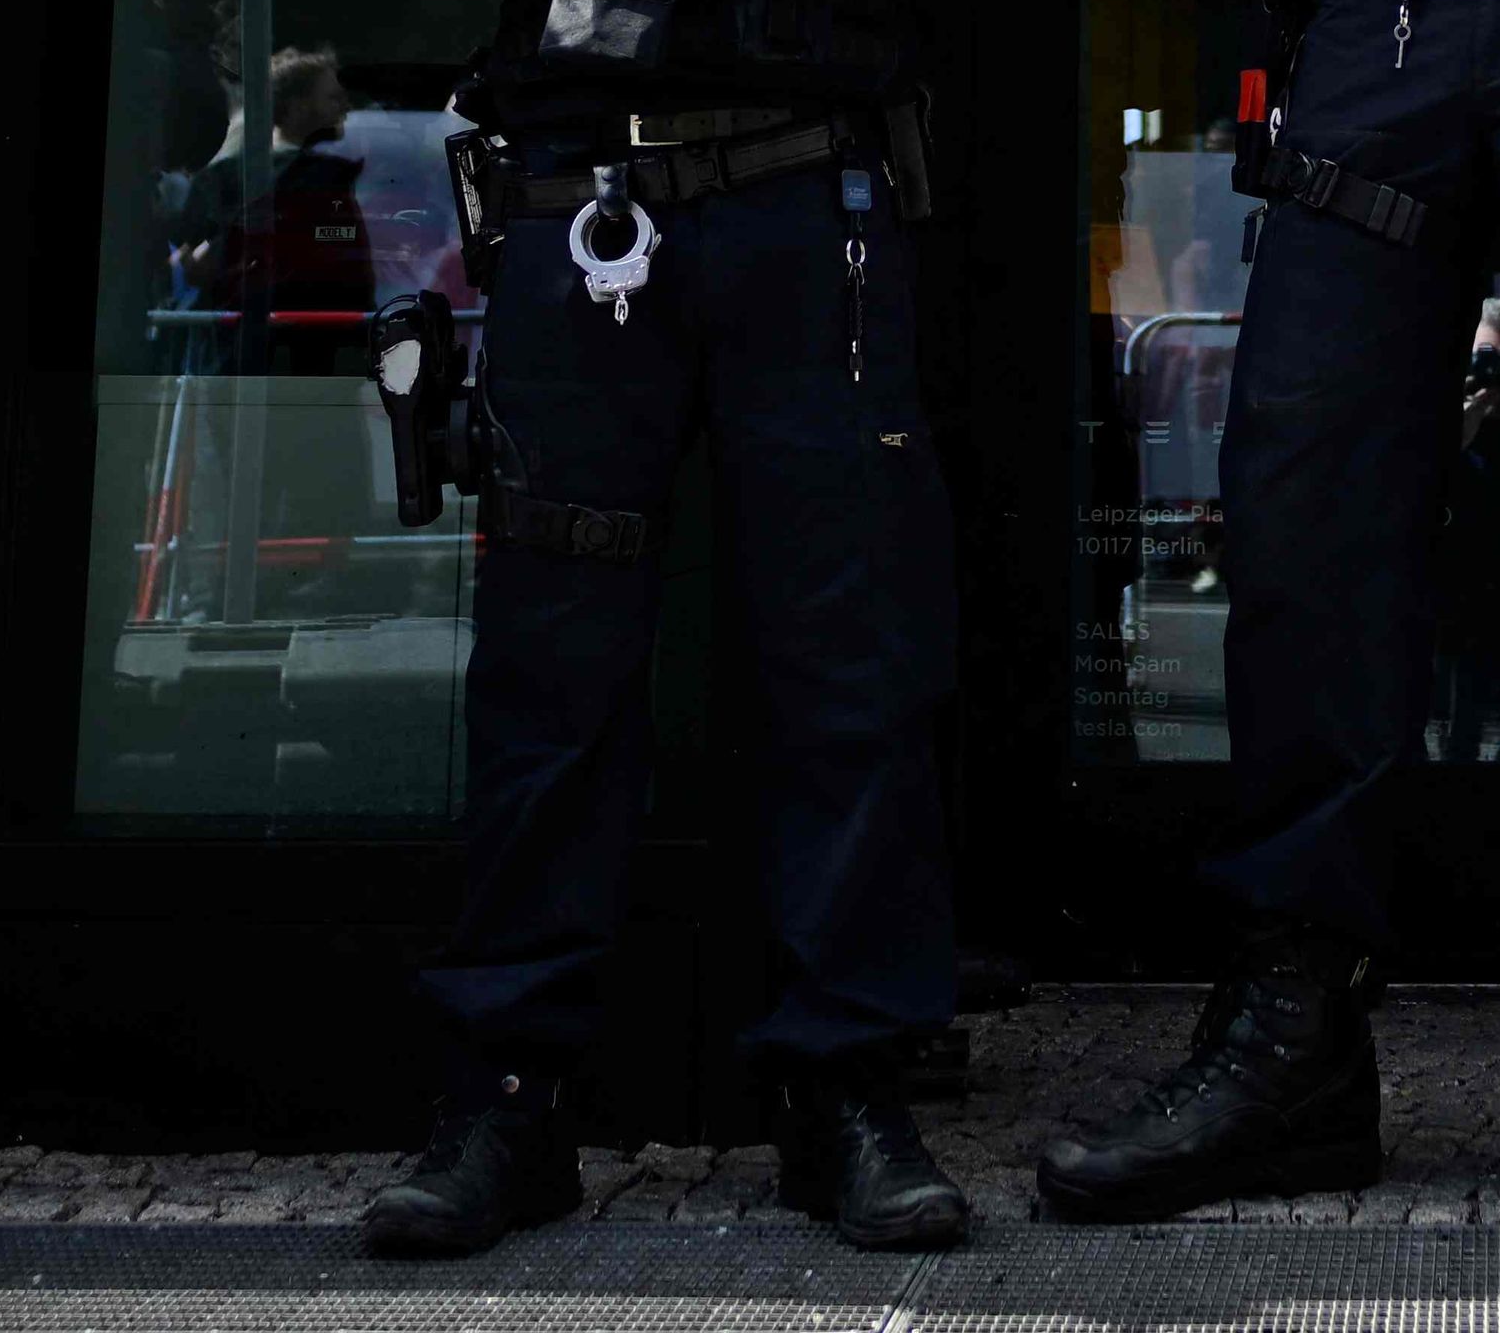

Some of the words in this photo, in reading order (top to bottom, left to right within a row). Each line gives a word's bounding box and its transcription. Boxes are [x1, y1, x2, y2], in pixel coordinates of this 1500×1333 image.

[1077, 504, 1184, 526] Leipziger
[1076, 536, 1132, 555] 10117
[1141, 536, 1207, 555] Berlin
[1075, 621, 1150, 641] SALES
[1075, 654, 1181, 673] Mon-Sam
[1073, 686, 1169, 708] Sonntag
[1074, 718, 1183, 737] tesla.com
